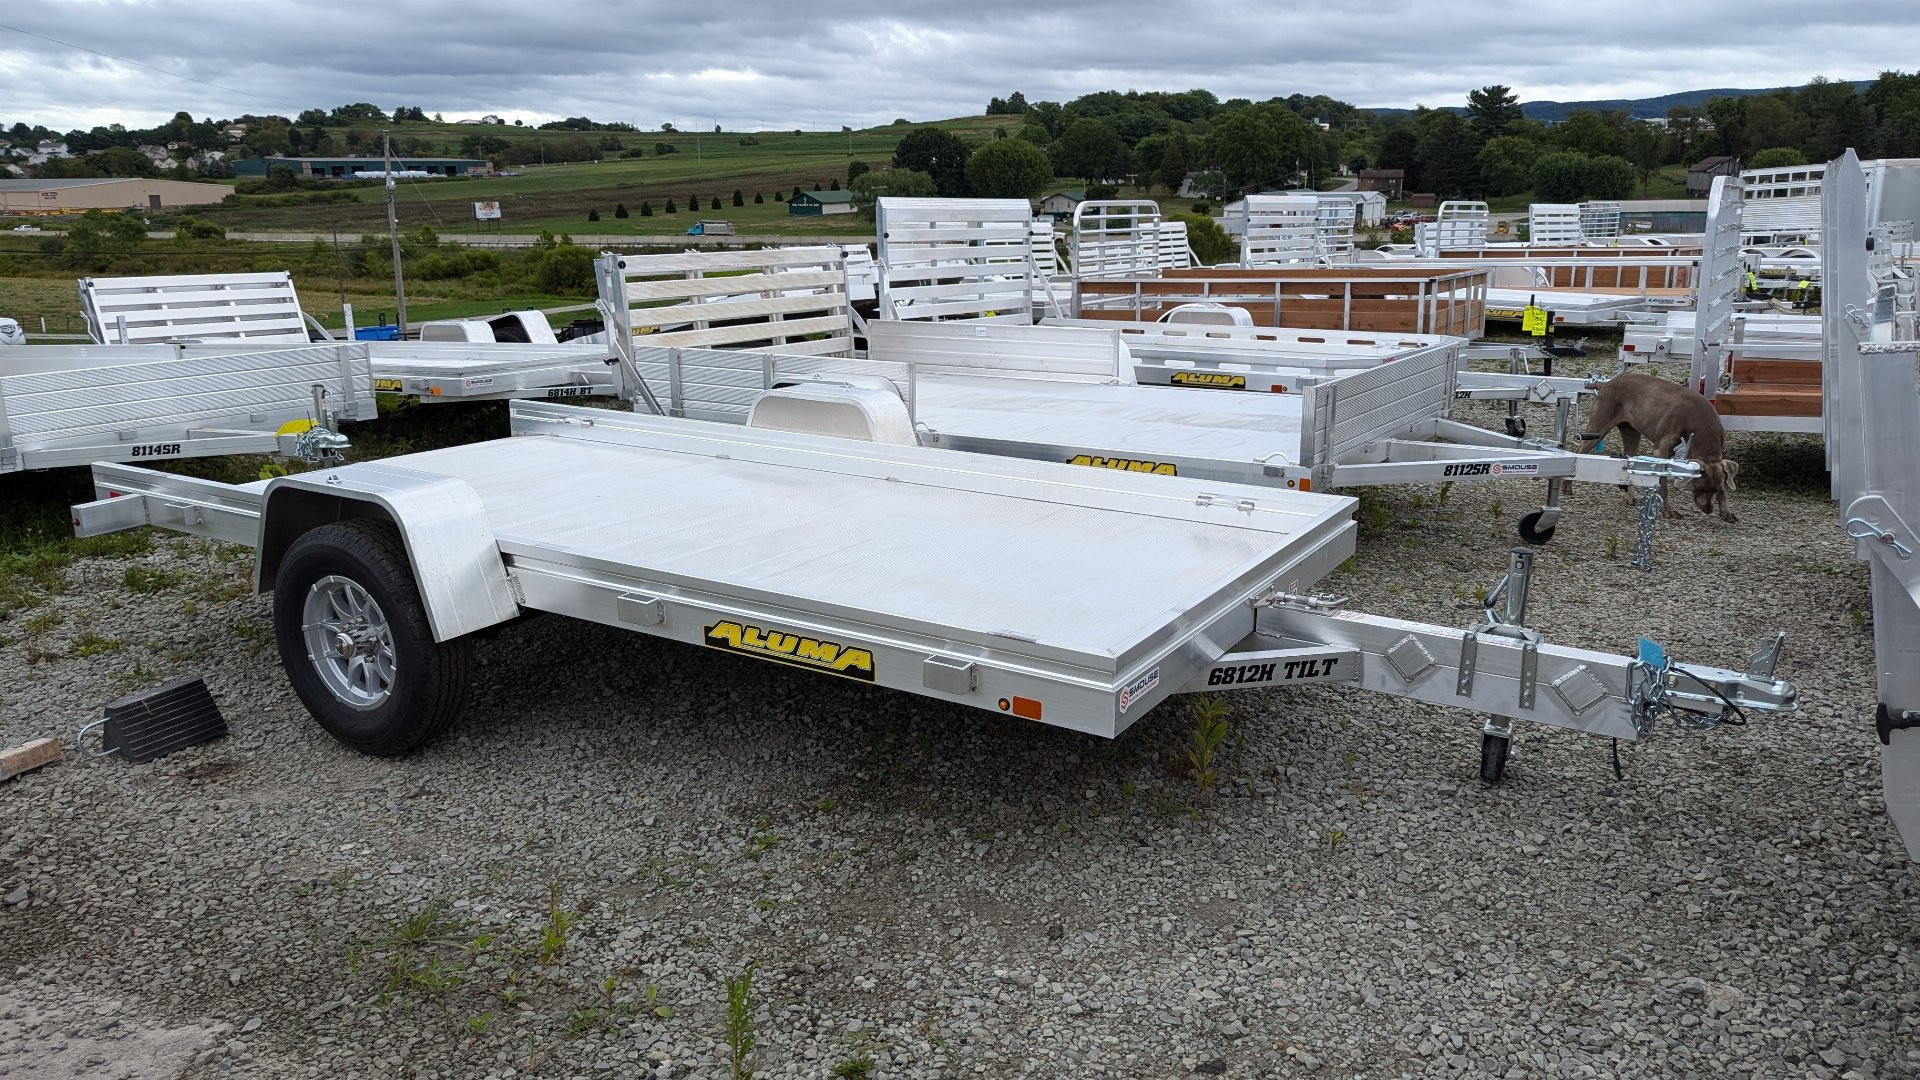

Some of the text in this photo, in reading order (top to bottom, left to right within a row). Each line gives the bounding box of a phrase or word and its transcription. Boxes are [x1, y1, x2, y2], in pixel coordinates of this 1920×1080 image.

[1171, 372, 1245, 388] ALUMA
[548, 387, 593, 397] 6814H BT
[1455, 391, 1472, 399] 12H
[132, 444, 181, 456] 8114SR
[1070, 455, 1177, 476] ALUMA
[1443, 463, 1491, 477] 8112SR
[707, 620, 873, 672] ALUMA
[1207, 658, 1339, 686] 6812H TILT
[1128, 669, 1159, 698] SMOUSE
